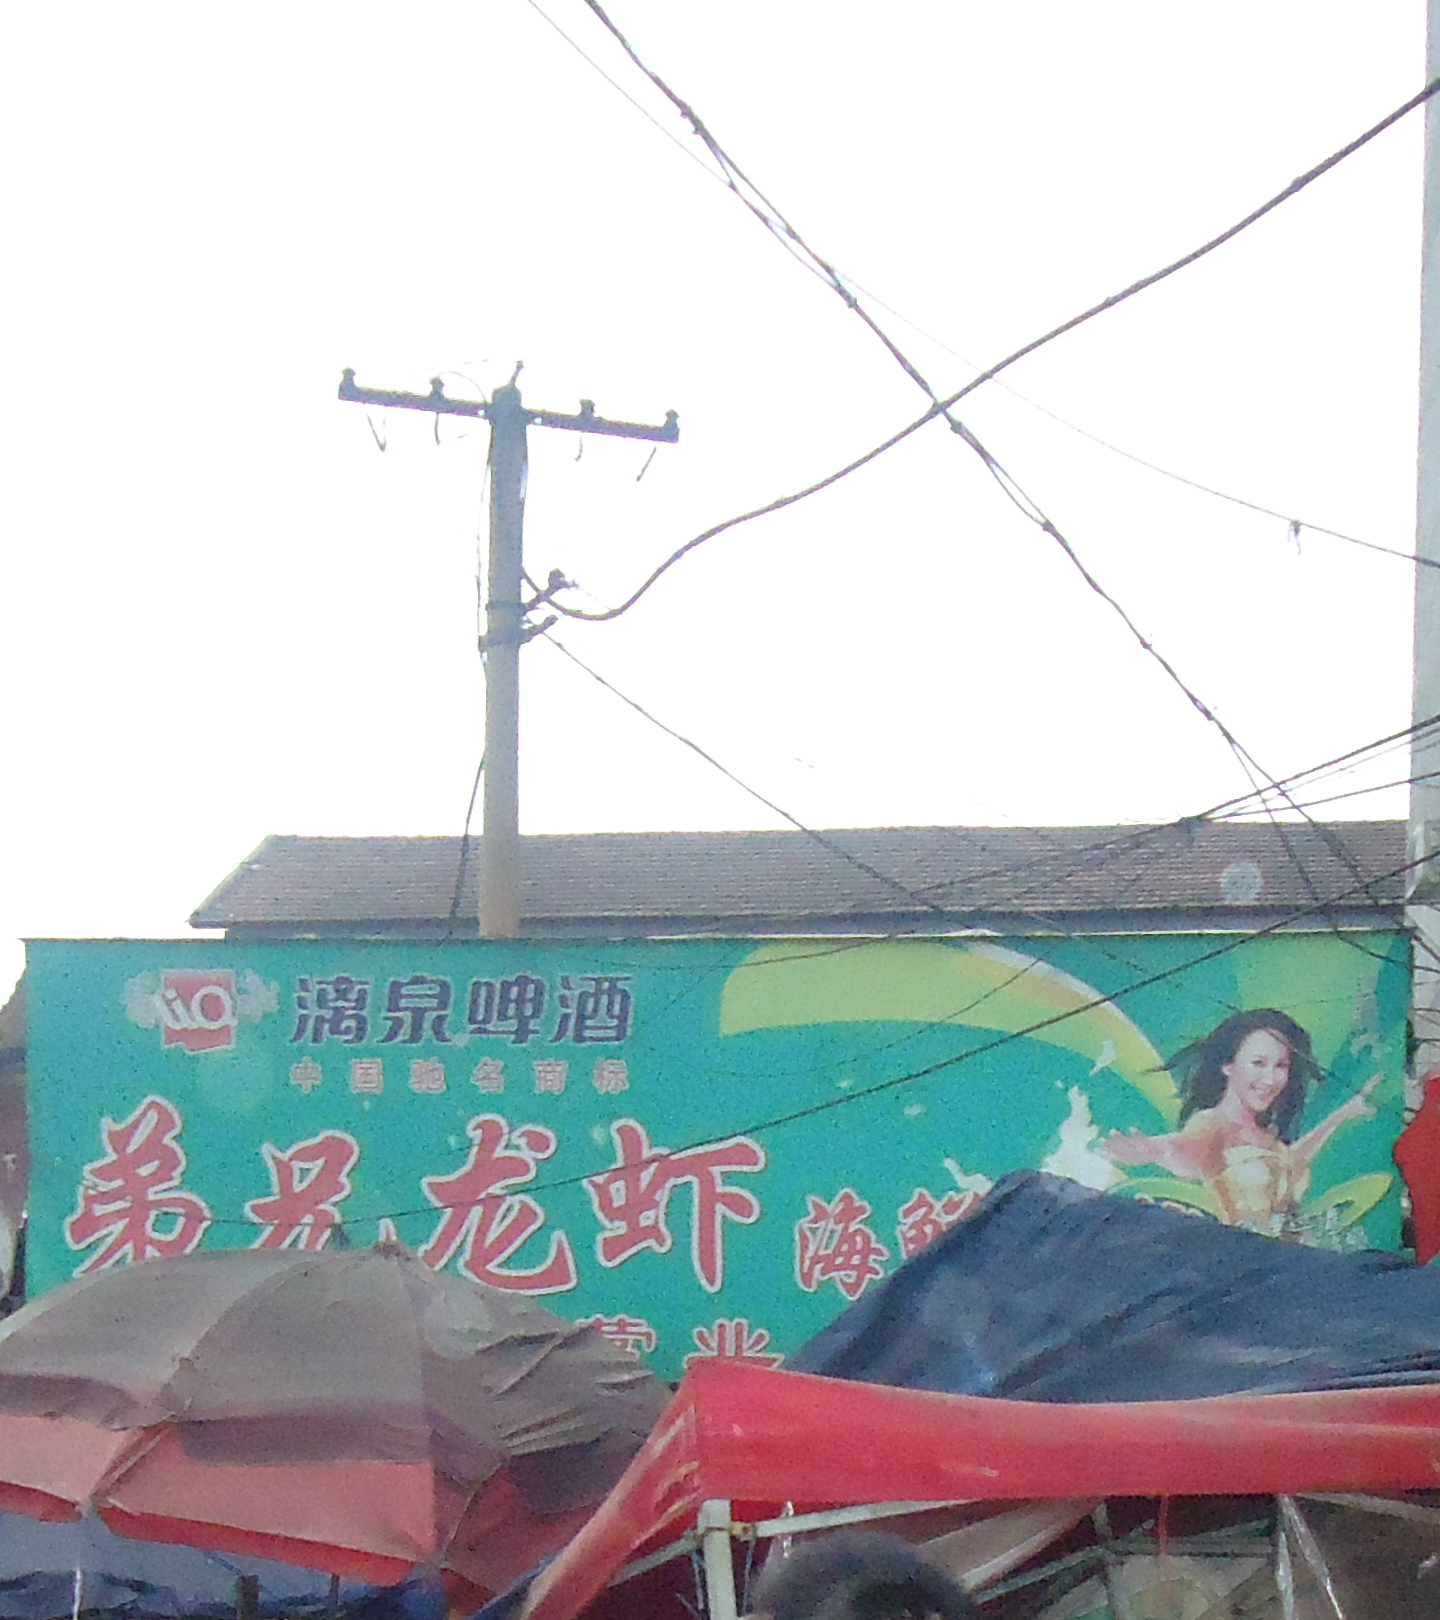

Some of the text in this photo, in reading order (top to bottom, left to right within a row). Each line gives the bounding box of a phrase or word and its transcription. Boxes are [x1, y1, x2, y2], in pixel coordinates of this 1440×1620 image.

[288, 974, 632, 1045] 漓泉啤酒
[289, 1056, 631, 1095] 中国驰名商标
[66, 1096, 767, 1294] 弟兄龙虾
